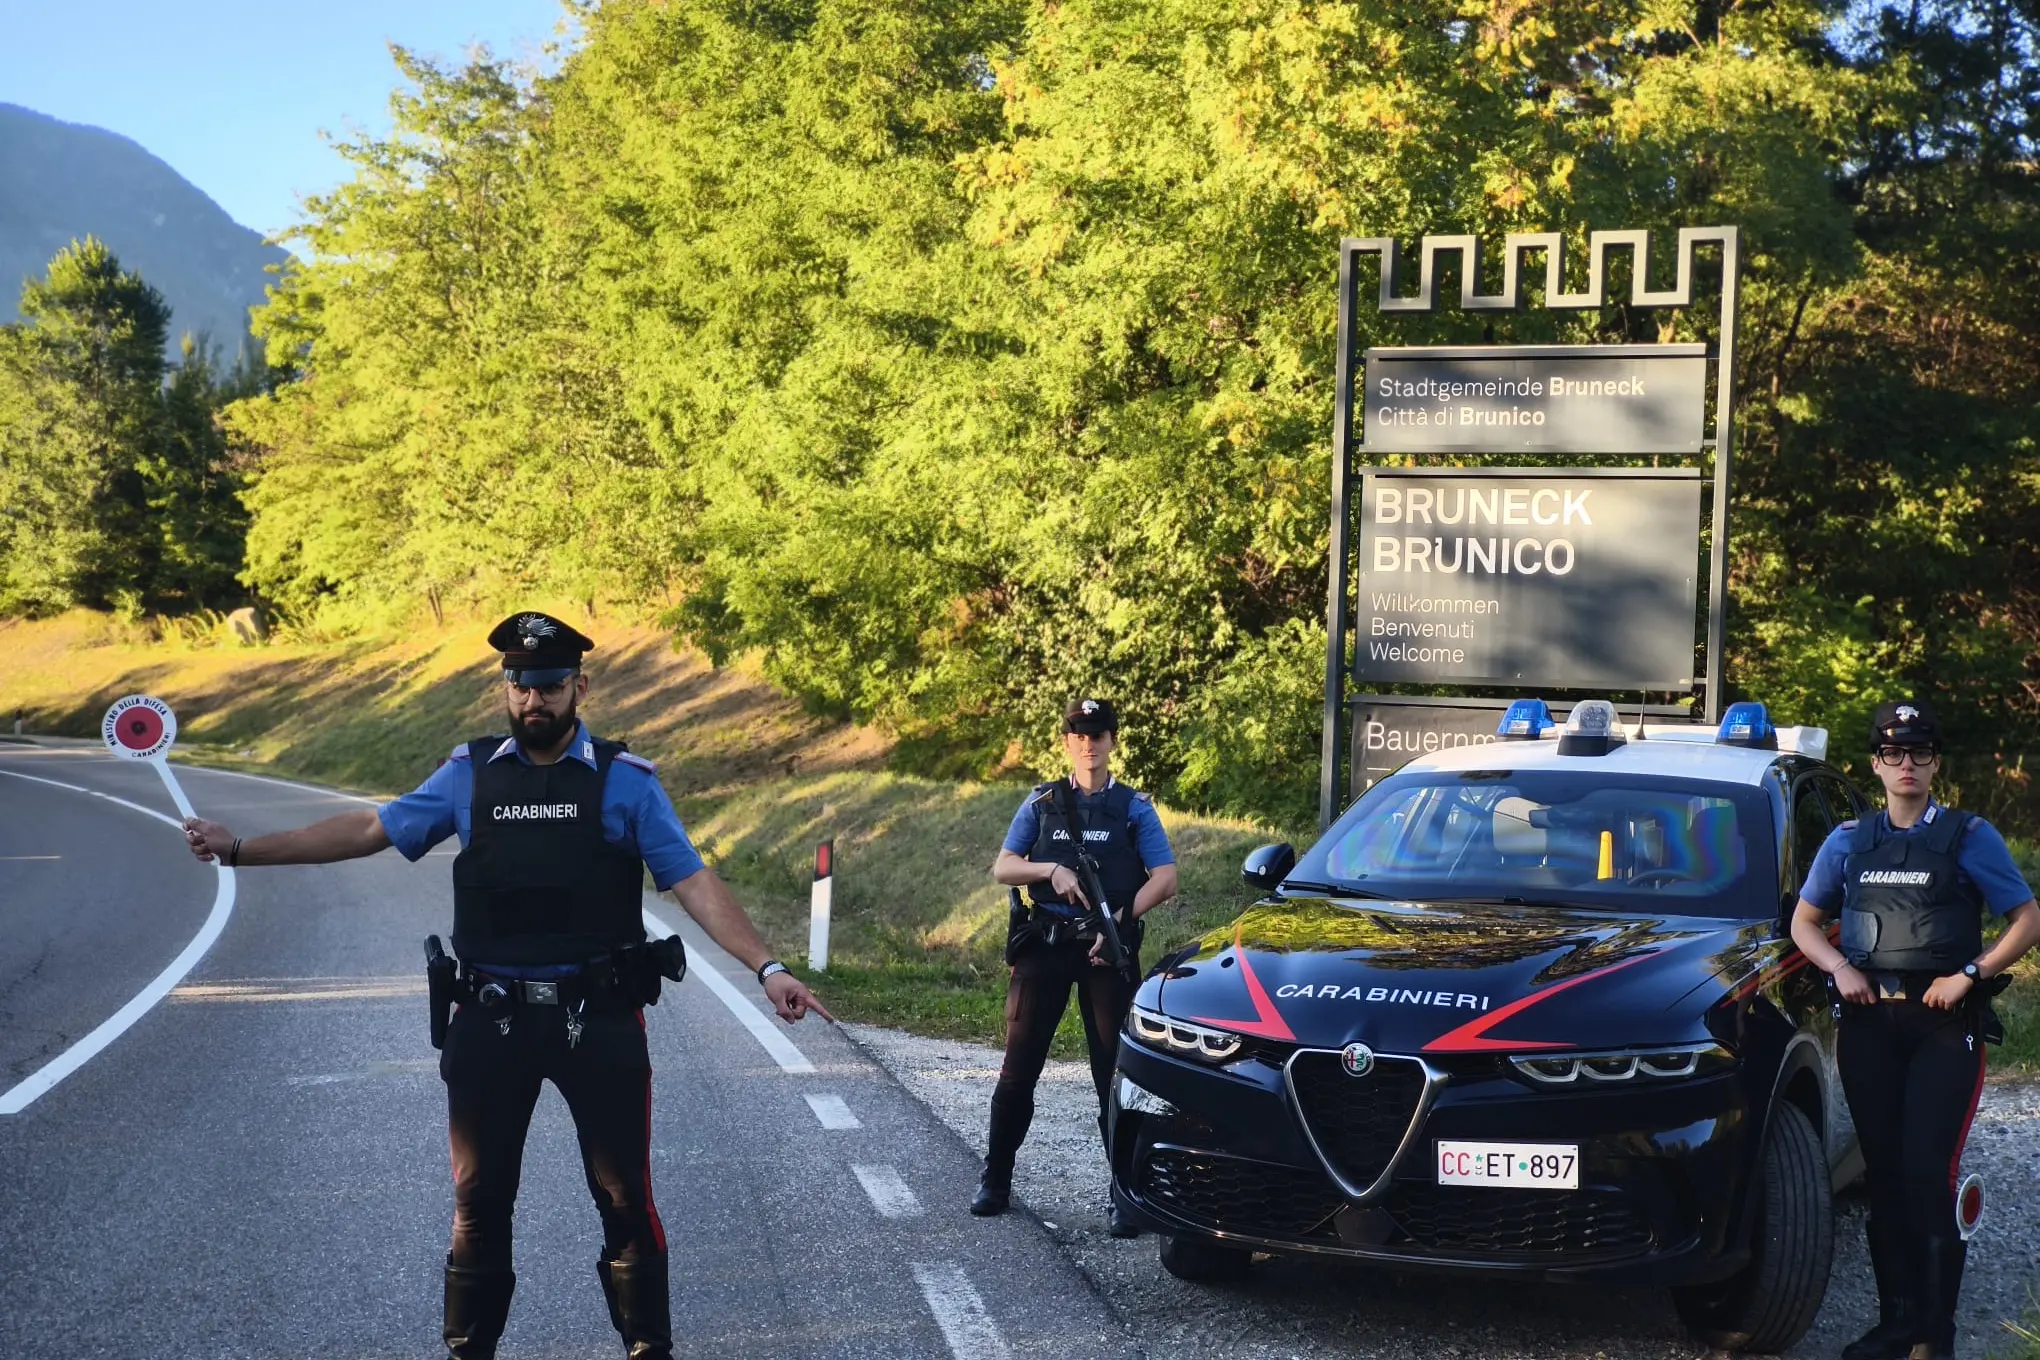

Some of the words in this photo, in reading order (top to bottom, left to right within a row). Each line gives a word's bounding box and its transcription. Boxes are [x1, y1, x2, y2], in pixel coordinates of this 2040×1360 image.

[1379, 376, 1543, 402] Stadtgemeinde
[1549, 376, 1645, 397] Bruneck
[1378, 406, 1428, 427] Città
[1434, 406, 1453, 427] di
[1459, 406, 1546, 427] Brunico
[1374, 488, 1593, 525] BRUNECK
[1373, 537, 1575, 575] BRUNICO
[1371, 592, 1500, 615] Willkommen
[1371, 618, 1475, 639] Benvenuti
[1370, 642, 1465, 663] Welcome
[105, 710, 118, 747] MINISTERO
[118, 698, 140, 710] DELLA
[144, 698, 167, 716] DIFESA
[1367, 721, 1496, 752] Bauernm
[493, 803, 578, 820] CARABINIERI
[1052, 829, 1110, 841] CAINIERI
[1859, 871, 1930, 885] CARABINIERI
[1275, 983, 1490, 1011] CARABINIERI
[1441, 1151, 1470, 1176] CC
[1486, 1153, 1516, 1177] ET
[1530, 1154, 1575, 1179] 897
